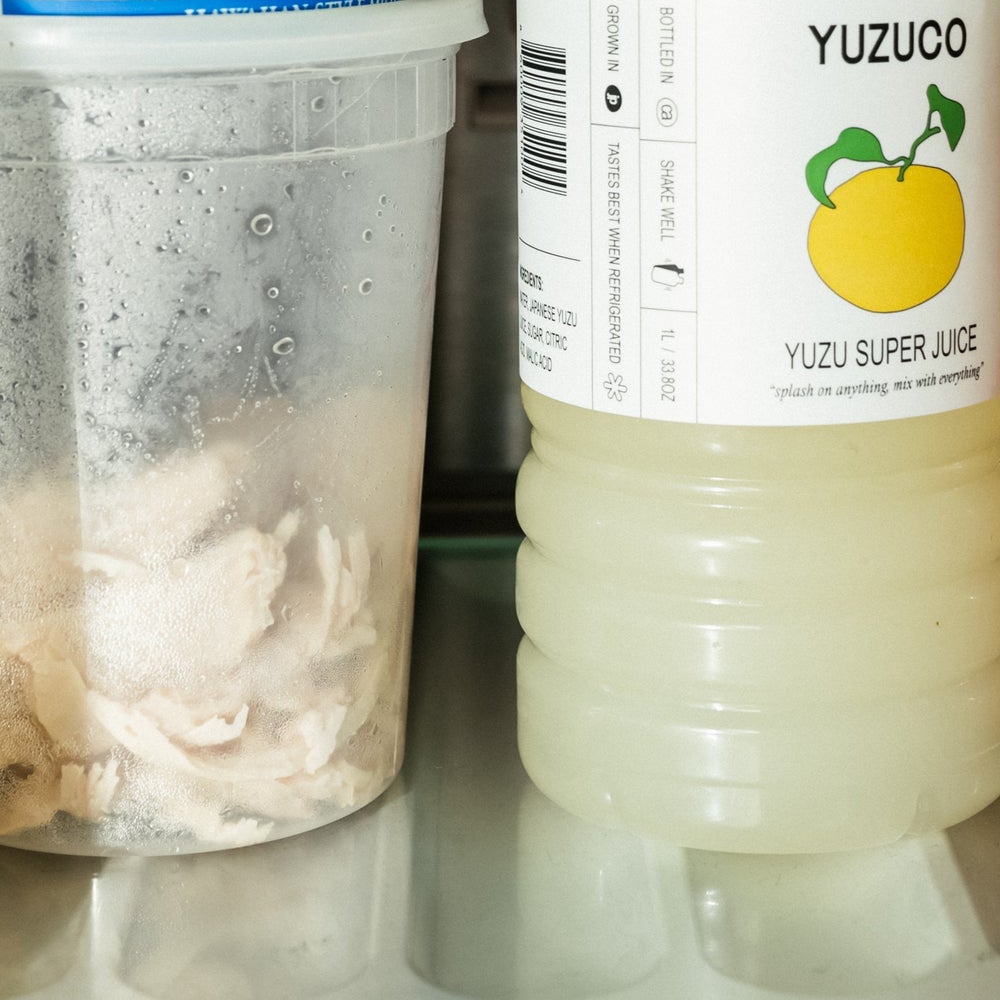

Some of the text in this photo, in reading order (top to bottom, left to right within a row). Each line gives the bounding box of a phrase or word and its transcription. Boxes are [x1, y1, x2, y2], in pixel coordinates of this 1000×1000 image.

[606, 4, 619, 72] GROWN IN
[659, 7, 674, 84] BOTTLED IN
[809, 18, 967, 64] YUZUCO
[660, 160, 675, 242] SHAKE WELL
[608, 143, 621, 364] TASTES BEST WHEN REFRIGERATED
[529, 299, 556, 321] JAPANESE
[557, 308, 577, 327] YUZU
[661, 329, 675, 341] 1L
[546, 331, 568, 351] CITRIC
[785, 324, 977, 369] YUZU SUPER JUICE
[661, 359, 675, 402] 33.8OZ
[770, 361, 985, 400] “splash on anything, mix with everything”
